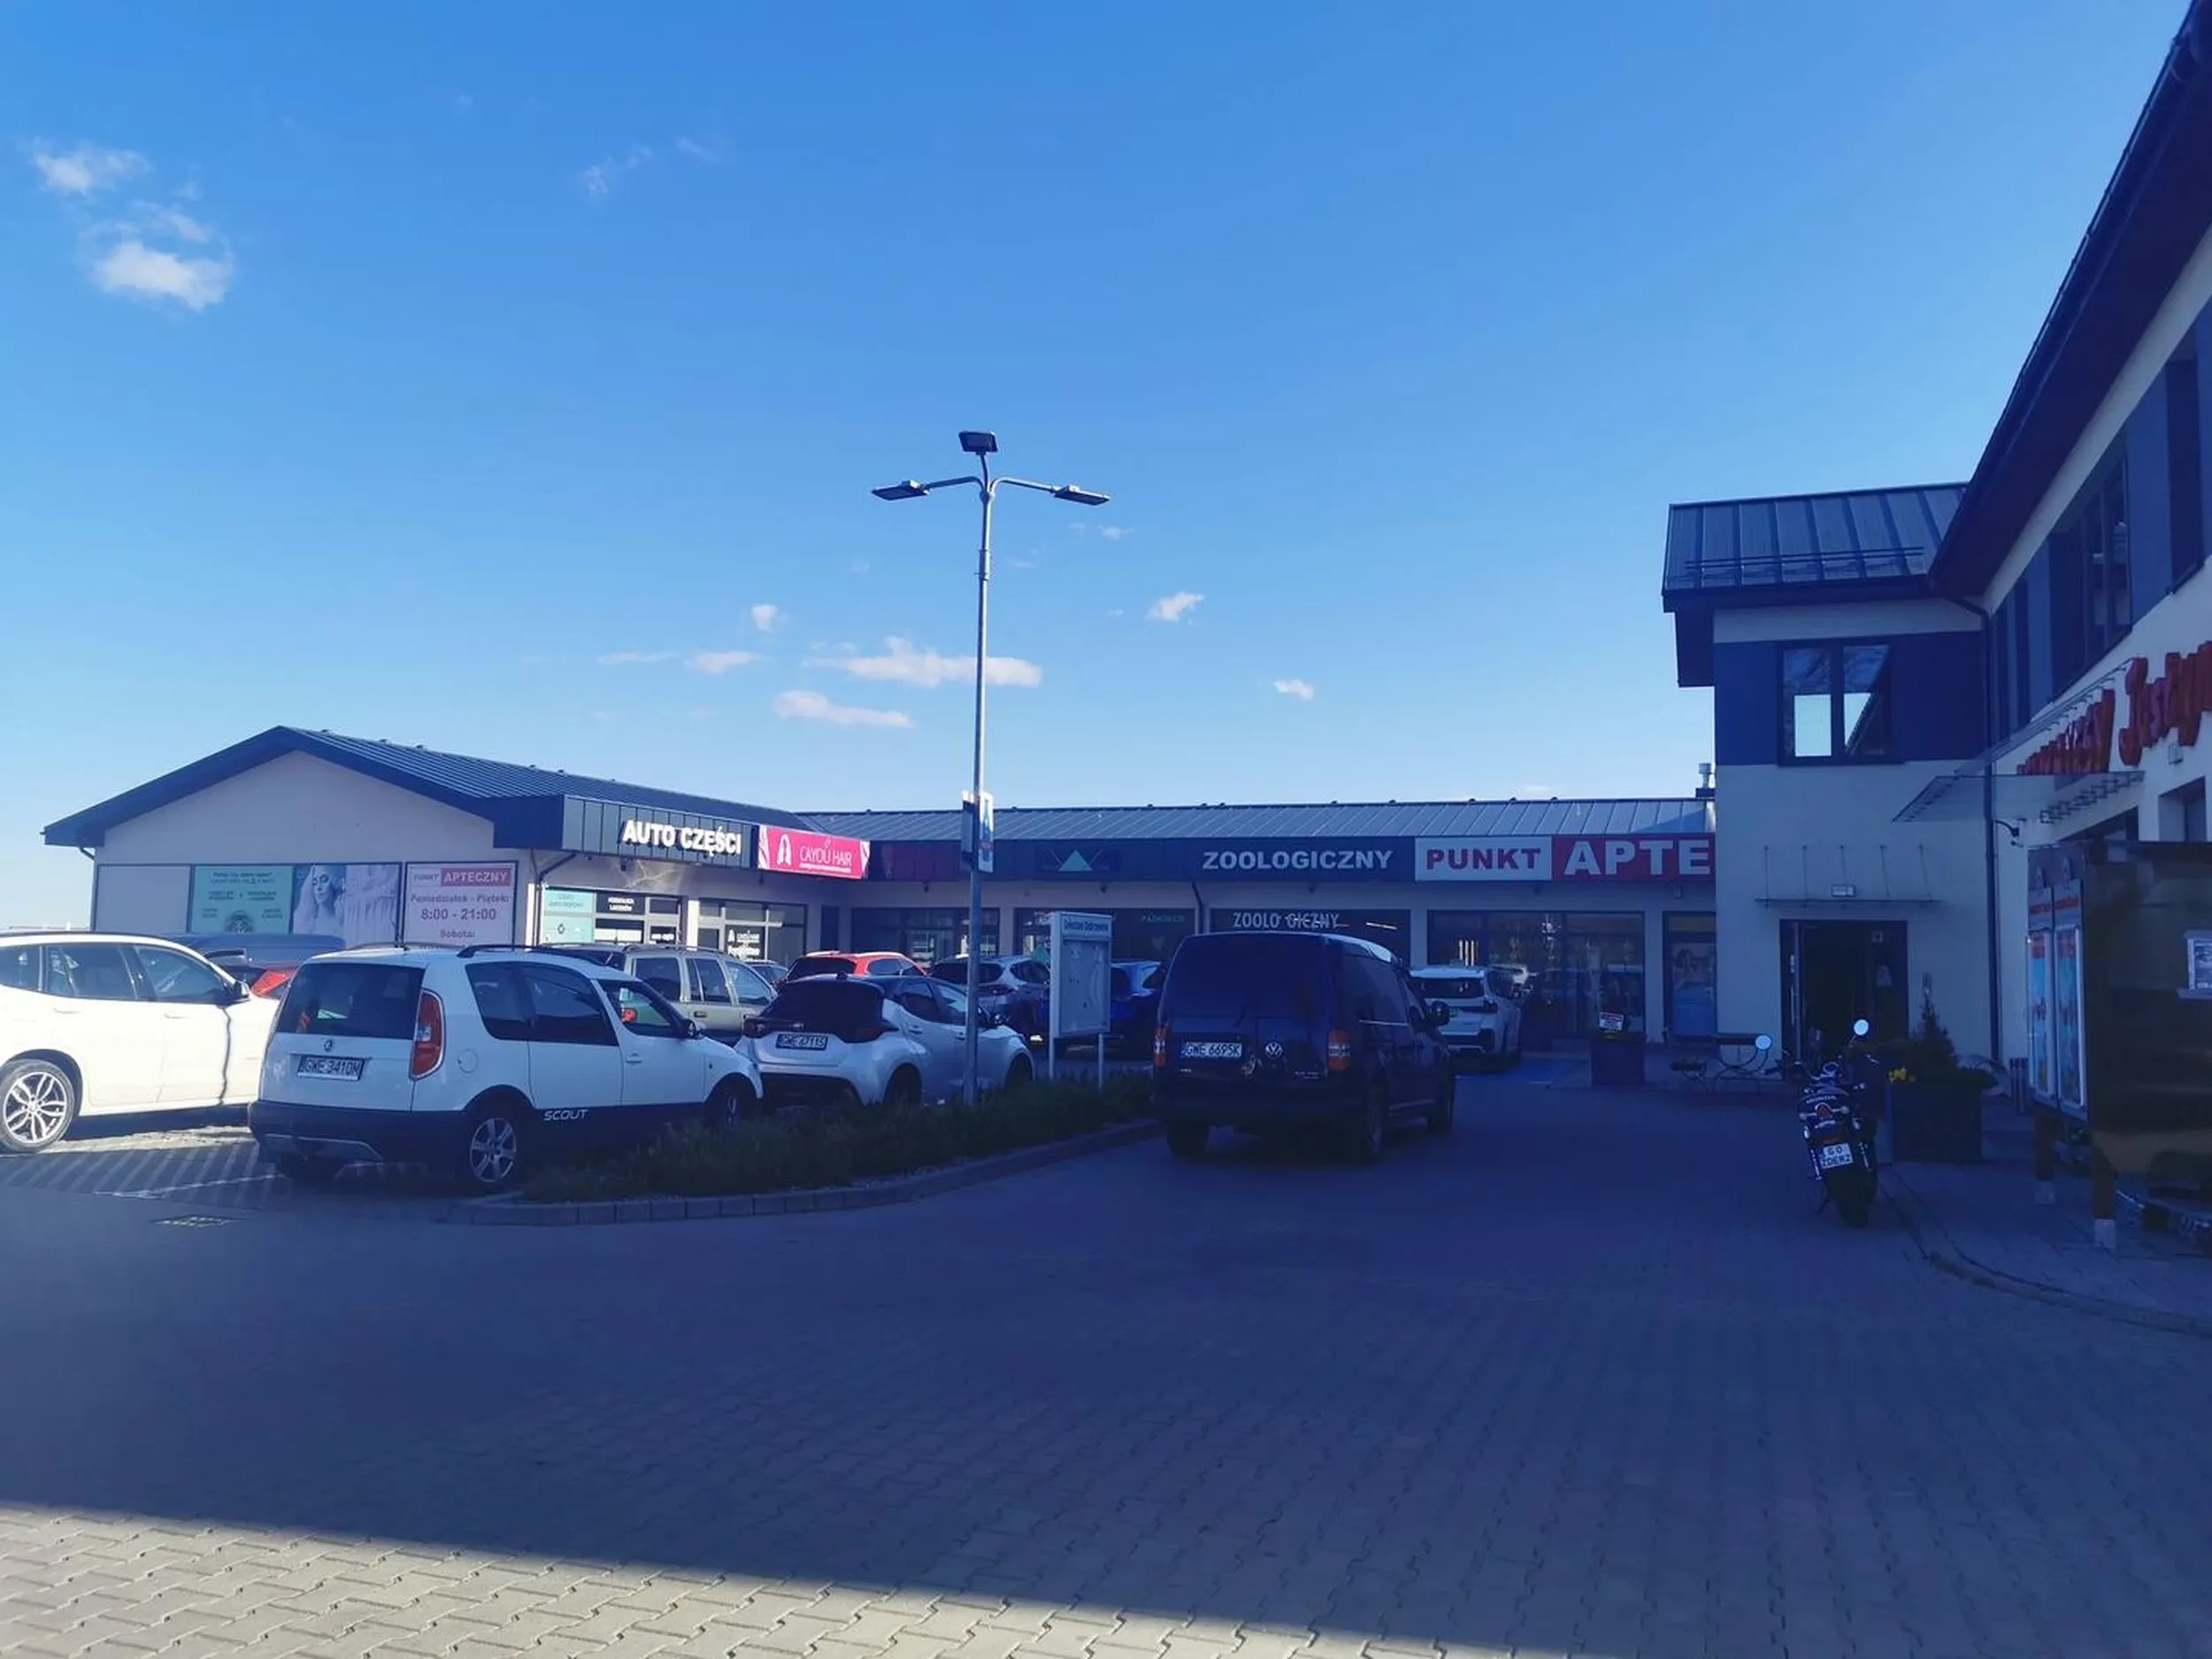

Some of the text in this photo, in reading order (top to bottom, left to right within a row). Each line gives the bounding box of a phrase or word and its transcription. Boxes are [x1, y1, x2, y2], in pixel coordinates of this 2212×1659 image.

[622, 819, 741, 856] AUTO CZĘŚCI
[832, 849, 853, 867] HAIR
[1202, 850, 1394, 870] ZOOLOGICZNY
[1426, 840, 1710, 875] PUNKT APTE
[443, 871, 507, 883] APTECZNY
[420, 908, 449, 920] 8:00
[460, 908, 497, 920] 21:00
[543, 1109, 588, 1121] SCOUT
